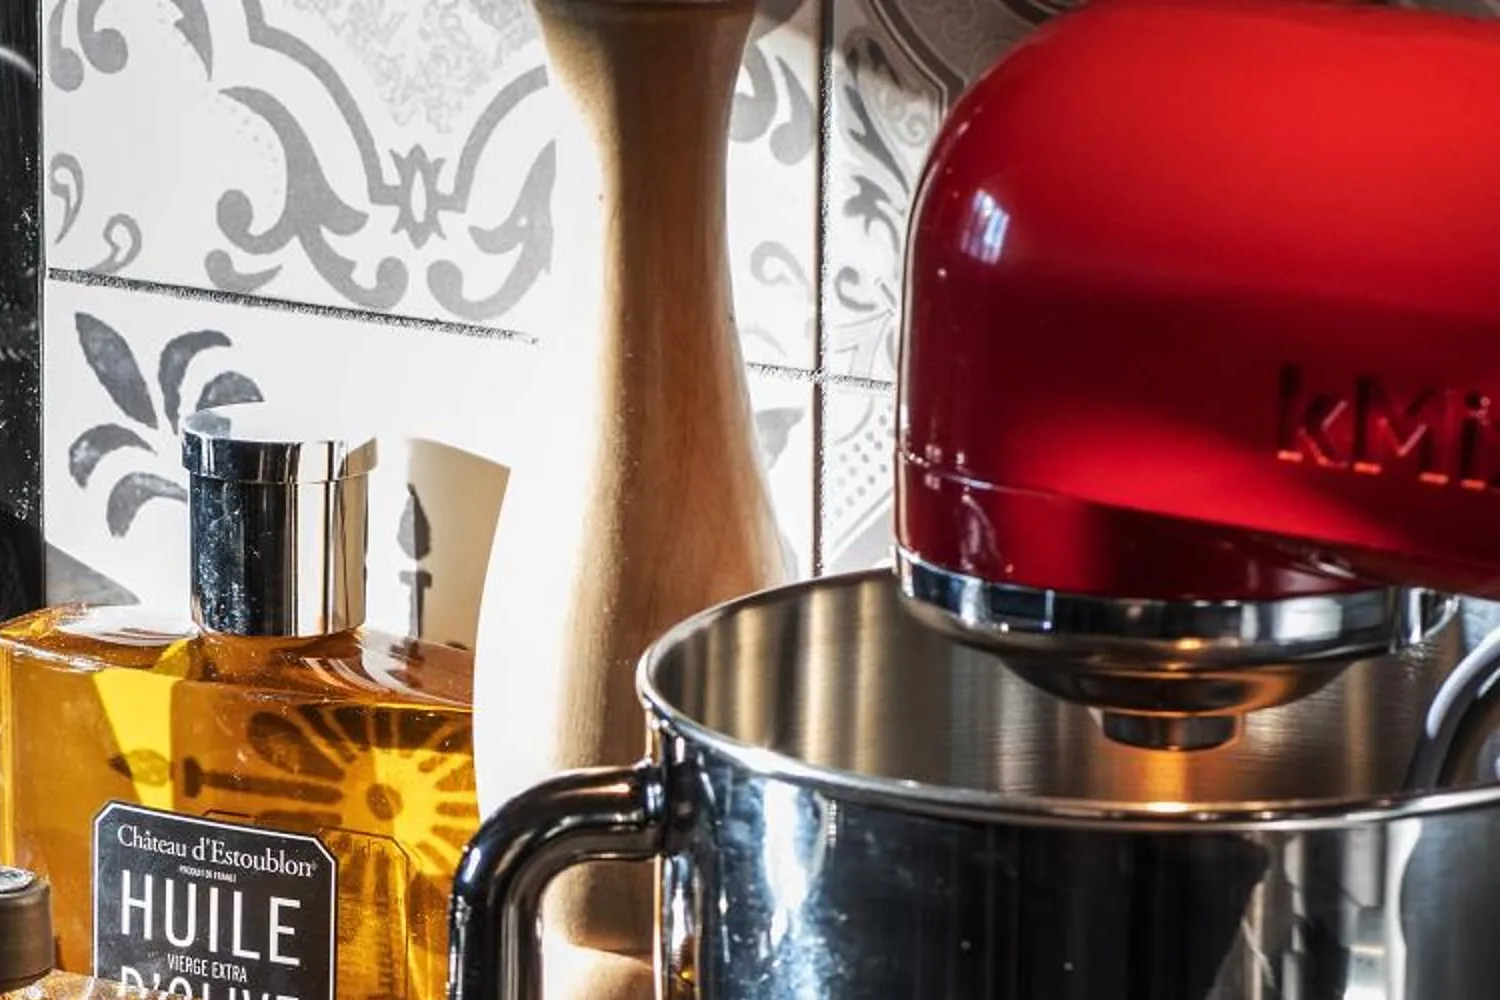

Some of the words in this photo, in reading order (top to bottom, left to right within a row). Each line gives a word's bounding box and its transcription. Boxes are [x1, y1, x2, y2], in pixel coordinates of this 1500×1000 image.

[1277, 363, 1500, 490] kMi
[117, 824, 187, 858] Château
[192, 837, 313, 877] d'Estoublon
[120, 869, 300, 967] HUILE
[167, 953, 208, 977] VIERGE
[211, 962, 248, 983] EXTRA
